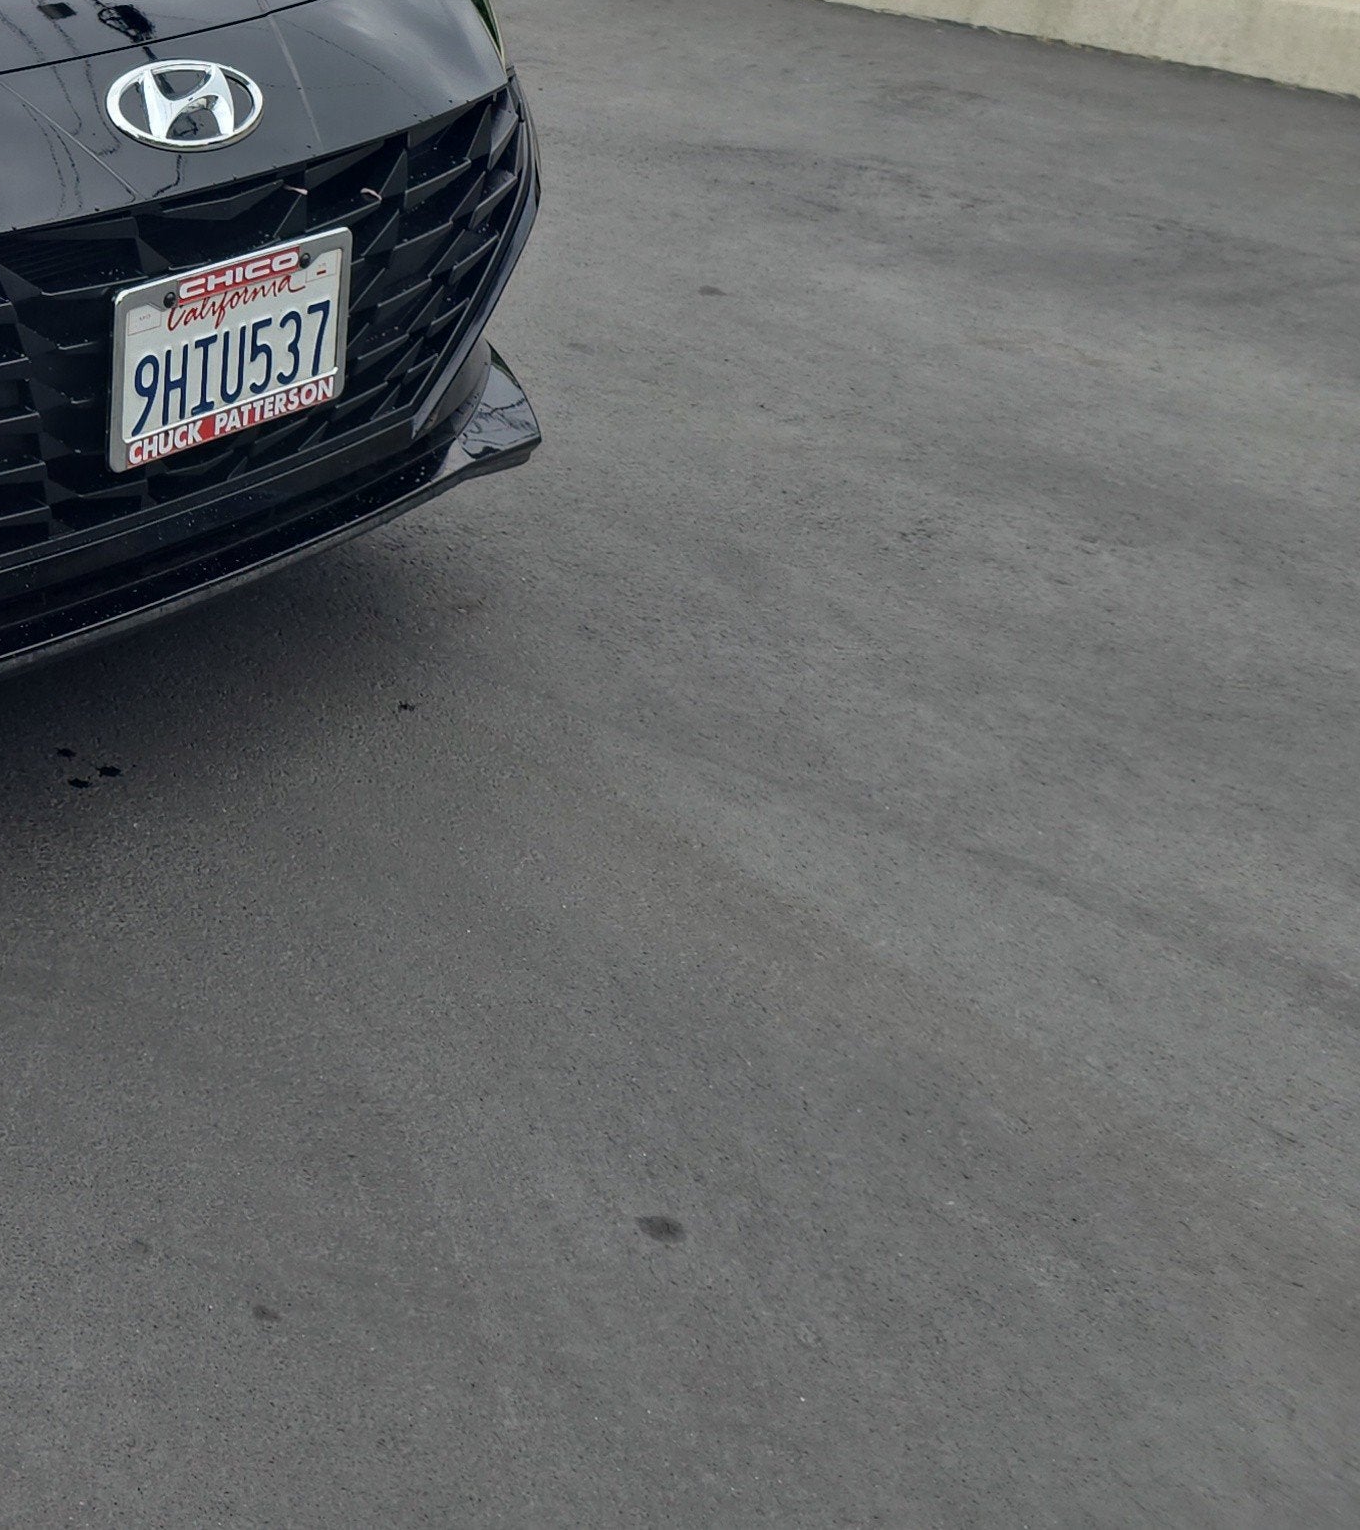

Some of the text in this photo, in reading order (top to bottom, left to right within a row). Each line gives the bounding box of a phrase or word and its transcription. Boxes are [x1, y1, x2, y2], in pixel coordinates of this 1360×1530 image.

[167, 274, 306, 331] California
[179, 251, 299, 299] CHICO
[131, 299, 331, 437] 9HIU537
[128, 377, 334, 465] CHUCK PATTERSON
